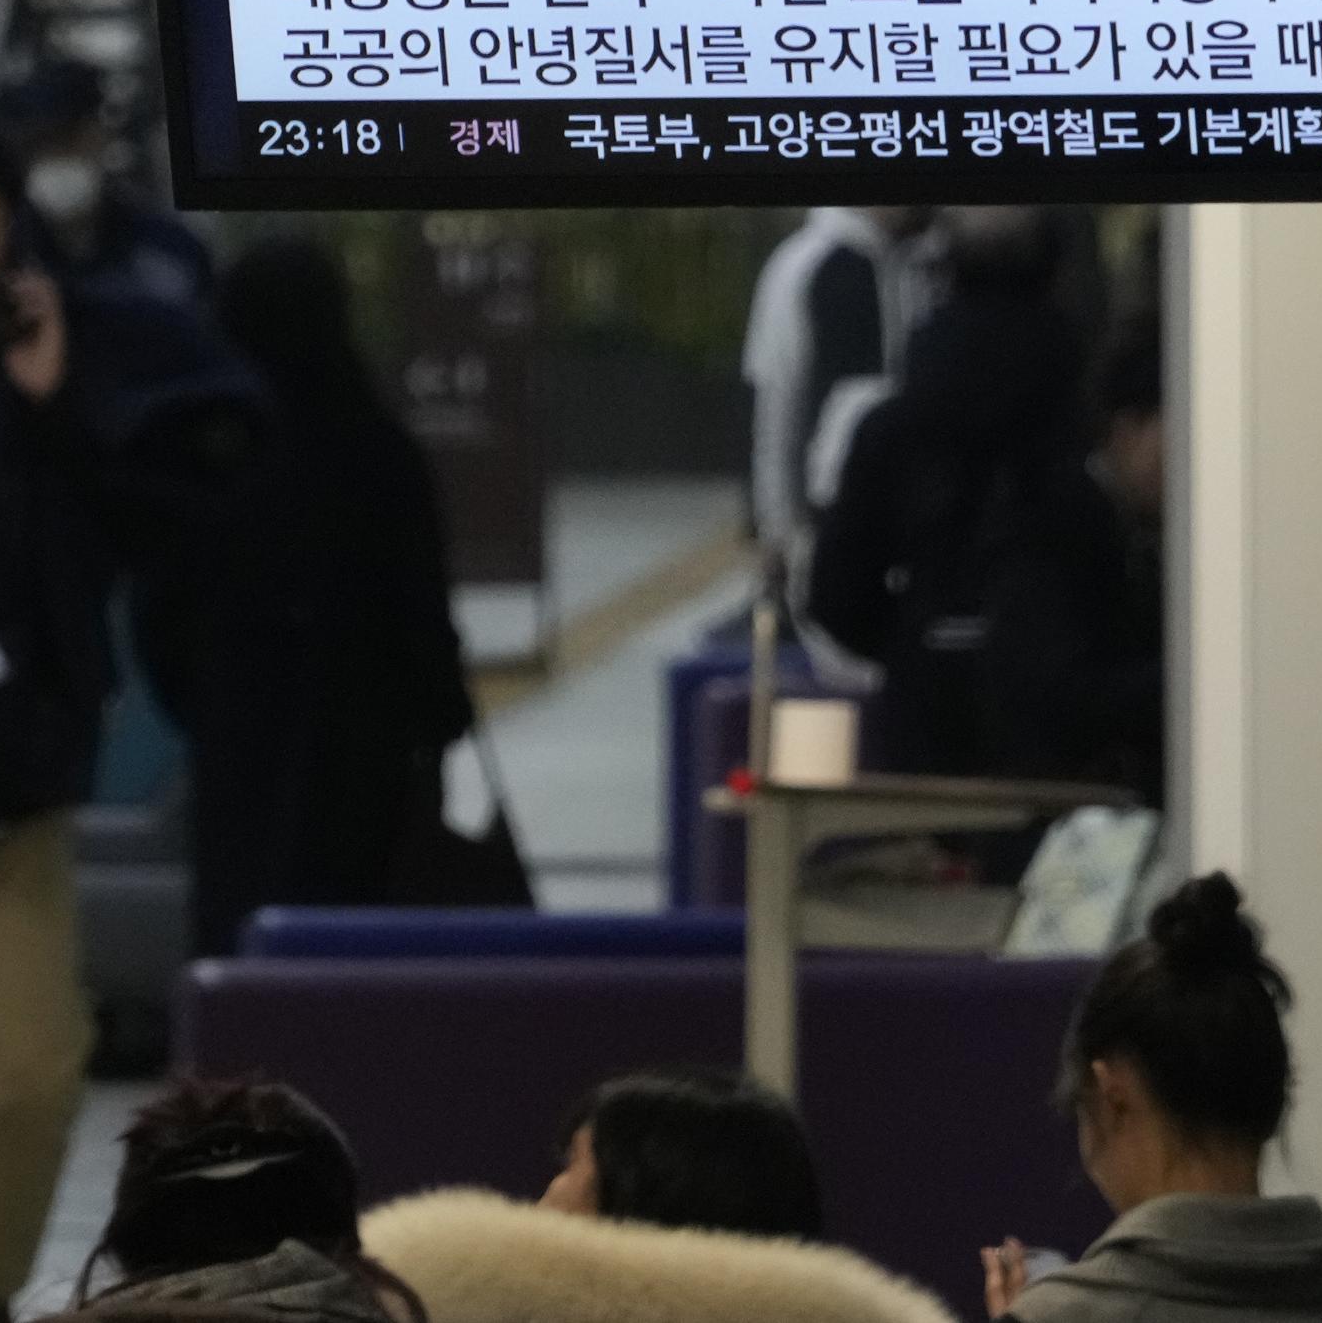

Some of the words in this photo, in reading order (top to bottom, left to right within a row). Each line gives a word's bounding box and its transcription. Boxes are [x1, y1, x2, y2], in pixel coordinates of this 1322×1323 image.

[284, 27, 449, 87] 공공의
[470, 25, 751, 86] 안녕질서를
[771, 23, 938, 83] 유지할
[958, 22, 1126, 82] 필요가
[1146, 21, 1256, 80] 있을
[259, 120, 381, 156] 23:18
[450, 119, 520, 155] 경제
[564, 114, 711, 160] 국토부,
[725, 110, 948, 158] 고양은평선
[962, 109, 1144, 156] 광역철도
